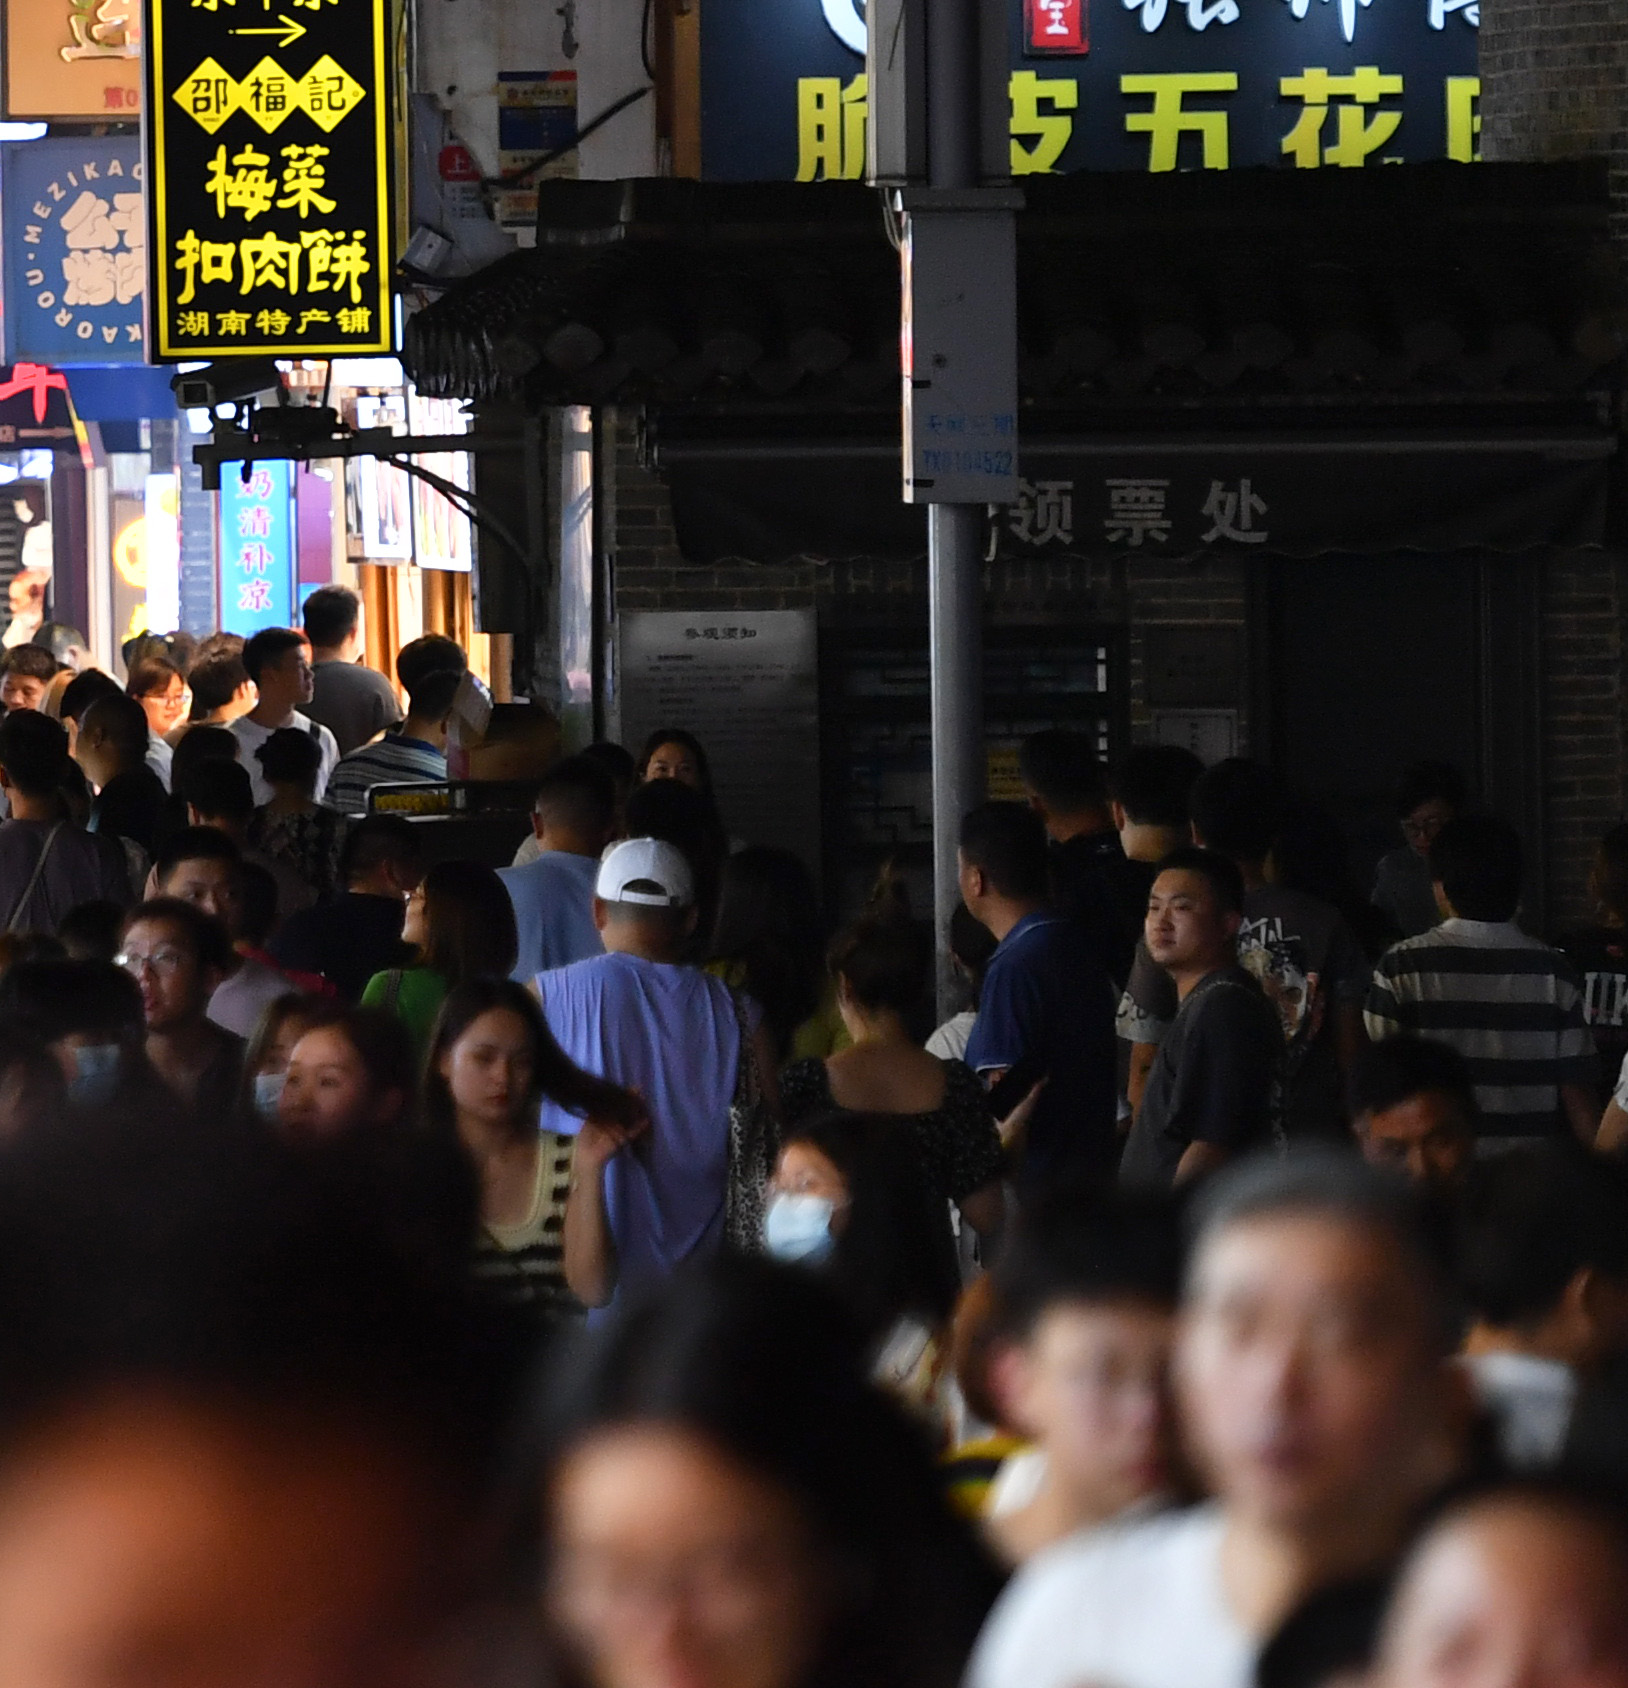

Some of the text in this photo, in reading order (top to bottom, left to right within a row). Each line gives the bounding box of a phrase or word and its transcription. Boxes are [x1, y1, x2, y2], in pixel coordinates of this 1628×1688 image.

[190, 75, 346, 116] 邵福記
[206, 144, 337, 223] 梅菜
[174, 230, 371, 306] 扣肉餅
[176, 307, 371, 338] 湖南特产铺
[1006, 475, 1273, 547] 领票处
